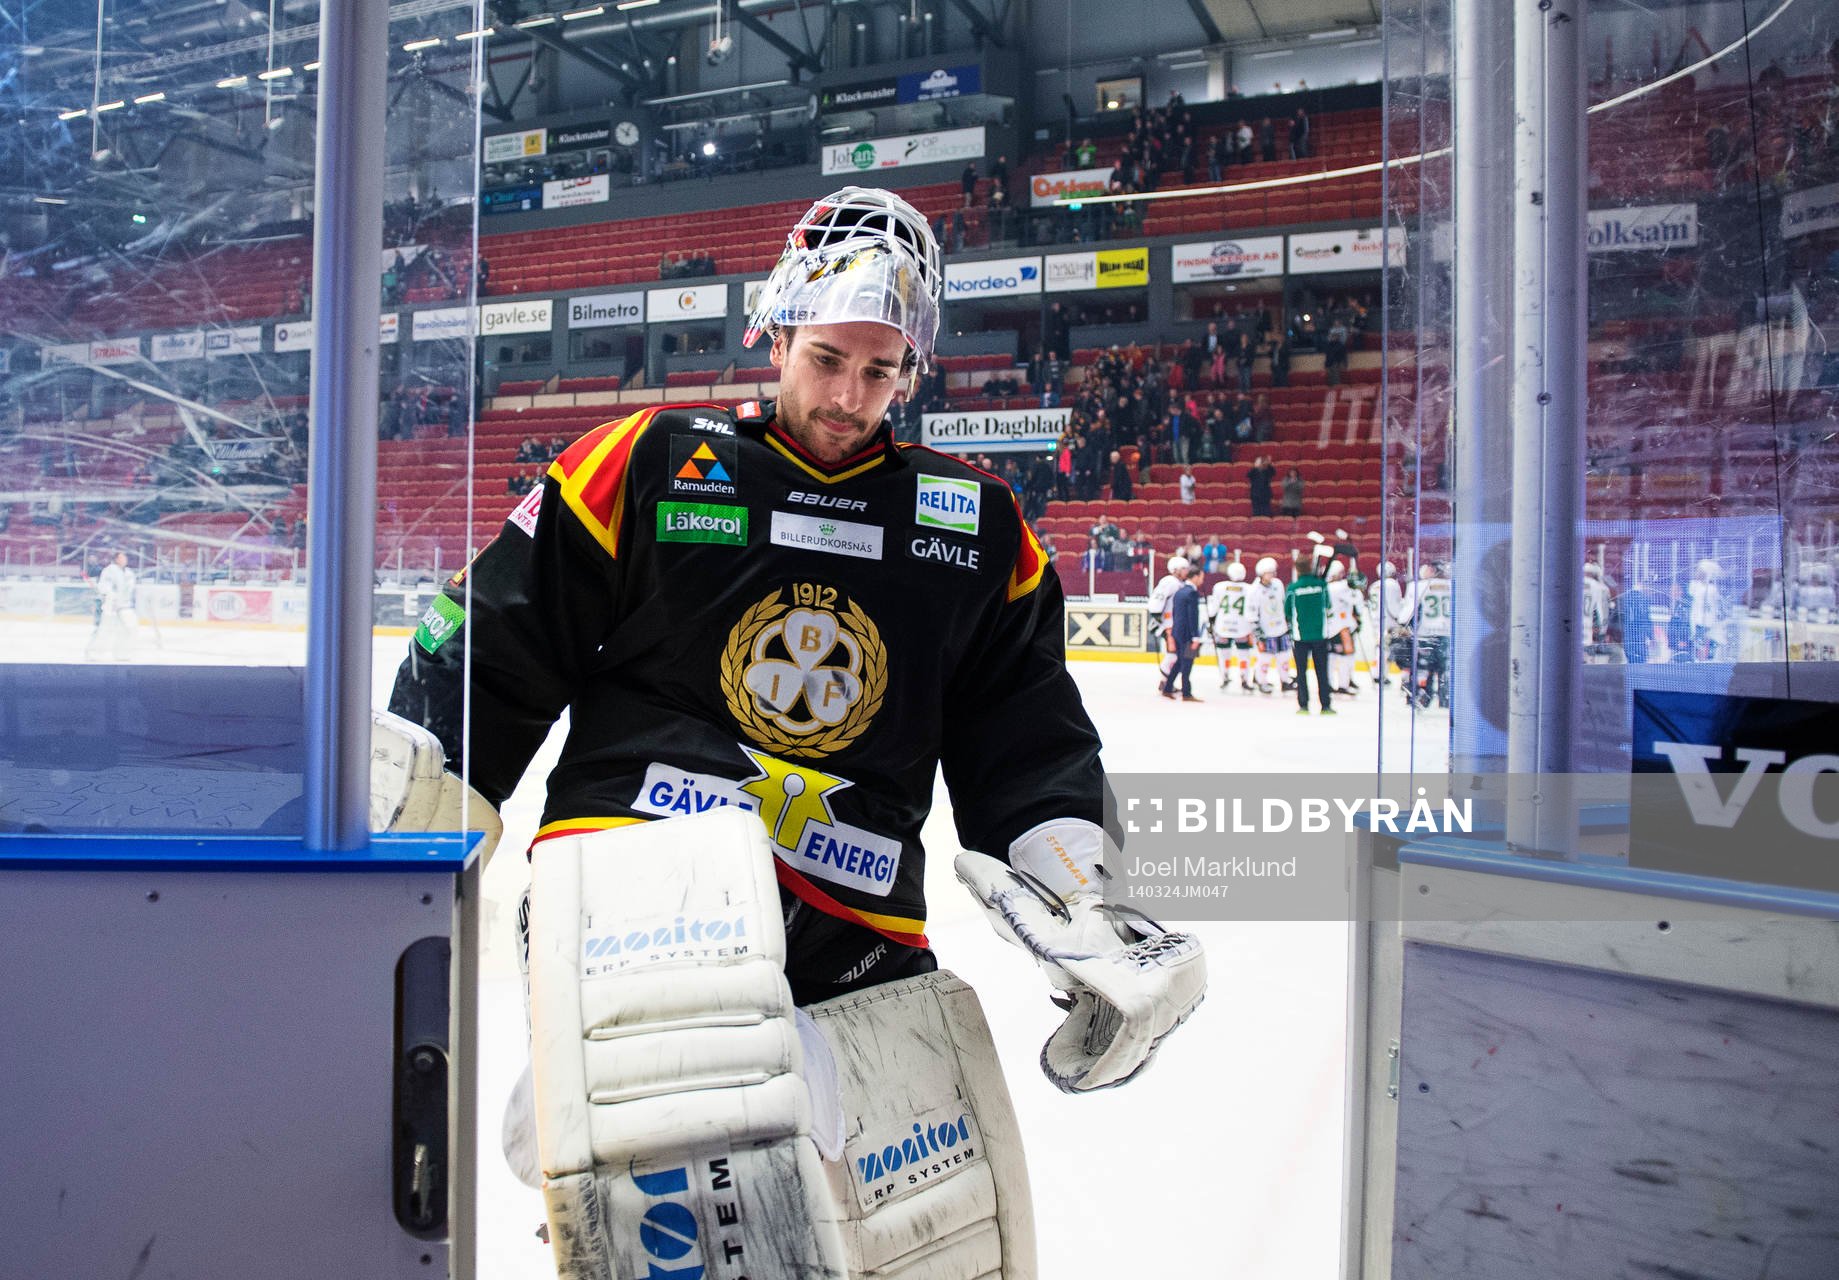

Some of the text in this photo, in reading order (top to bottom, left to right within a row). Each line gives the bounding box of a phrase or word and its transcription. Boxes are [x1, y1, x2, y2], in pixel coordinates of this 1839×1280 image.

[1588, 221, 1689, 246] olksam
[948, 274, 1018, 291] Nordea
[486, 306, 548, 330] gavle.se
[573, 303, 639, 320] Bilmetro
[692, 417, 735, 435] SHL
[929, 414, 1067, 440] Gefle Dagblad
[674, 479, 735, 495] Ramudden
[919, 490, 977, 516] RELITA
[665, 511, 741, 536] Läkerol
[780, 530, 872, 553] BILLERUDKORSNÄS
[911, 537, 980, 571] GÄVLE
[792, 582, 838, 610] 1912
[1220, 595, 1245, 616] 44
[800, 625, 822, 651] B
[823, 681, 843, 707] F
[649, 777, 753, 815] GÄV
[804, 831, 896, 884] ENERGI
[585, 916, 746, 959] monitor
[586, 945, 748, 975] ERP SYSTEM
[832, 942, 887, 983] AUER
[857, 1113, 970, 1185] monitor
[908, 1147, 974, 1184] SYSTEM
